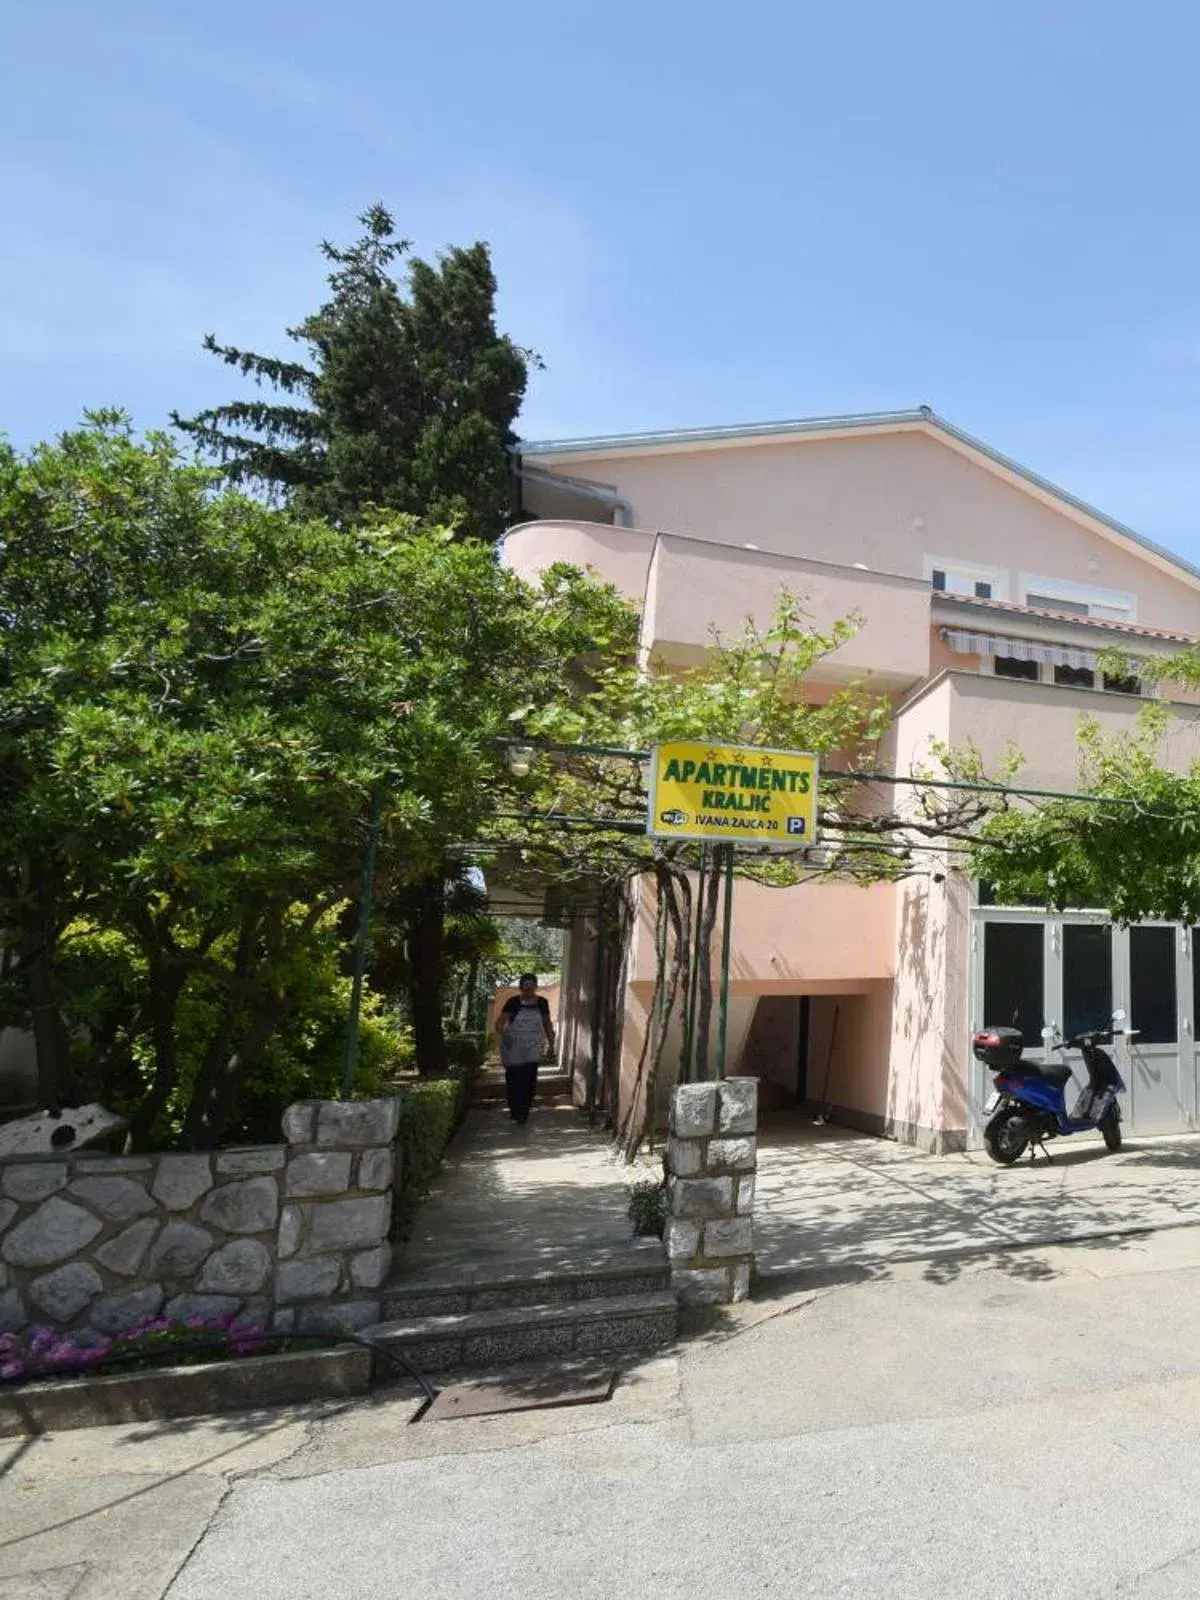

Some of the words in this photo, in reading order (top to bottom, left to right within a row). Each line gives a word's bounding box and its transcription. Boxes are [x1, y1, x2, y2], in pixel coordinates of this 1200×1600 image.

[663, 758, 811, 793] APARTMENTS
[702, 789, 772, 812] KRALJIĆ
[695, 814, 730, 827] IVANA
[731, 816, 765, 829] ZAJCA
[766, 819, 779, 830] 20
[790, 818, 803, 833] P
